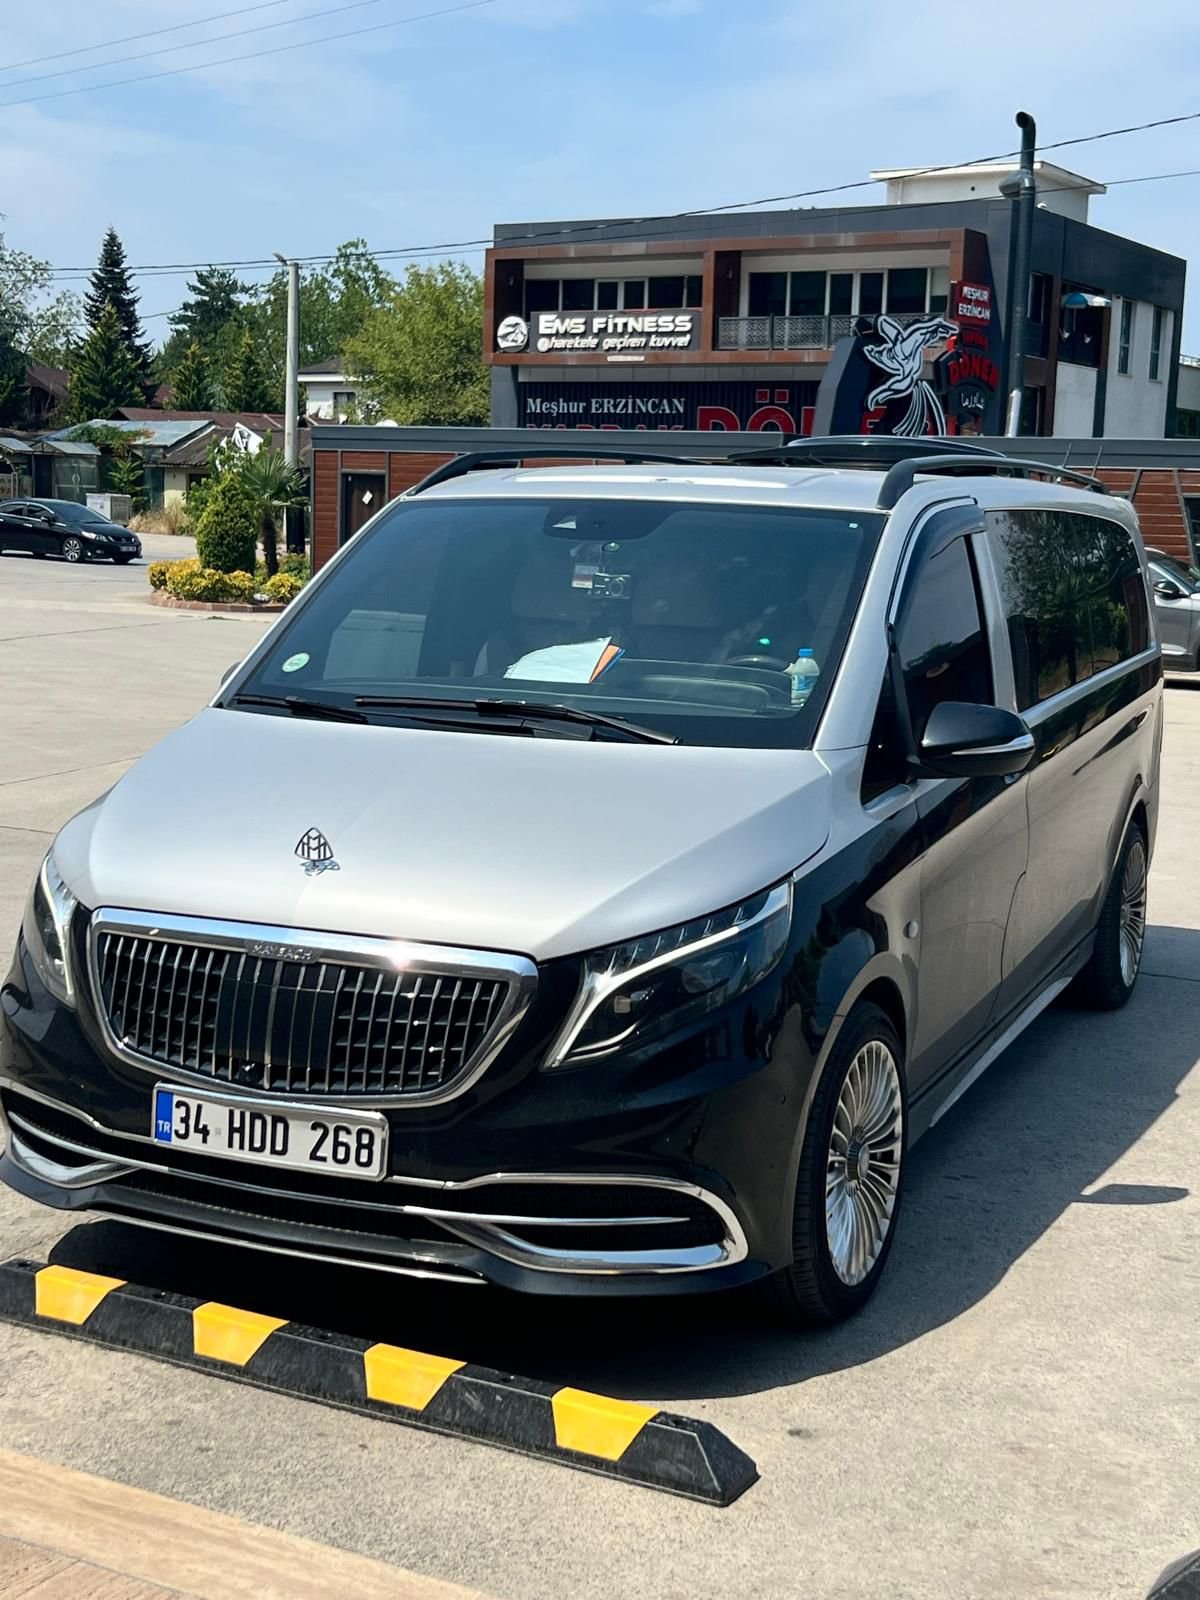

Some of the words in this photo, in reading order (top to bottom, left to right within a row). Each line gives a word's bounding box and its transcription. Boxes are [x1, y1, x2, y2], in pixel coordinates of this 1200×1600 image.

[526, 398, 586, 417] Meşhur
[590, 395, 685, 414] ERZİNCAN
[157, 1119, 171, 1134] TR
[174, 1100, 211, 1145] 34
[226, 1108, 290, 1157] HDD
[308, 1120, 376, 1169] 268
